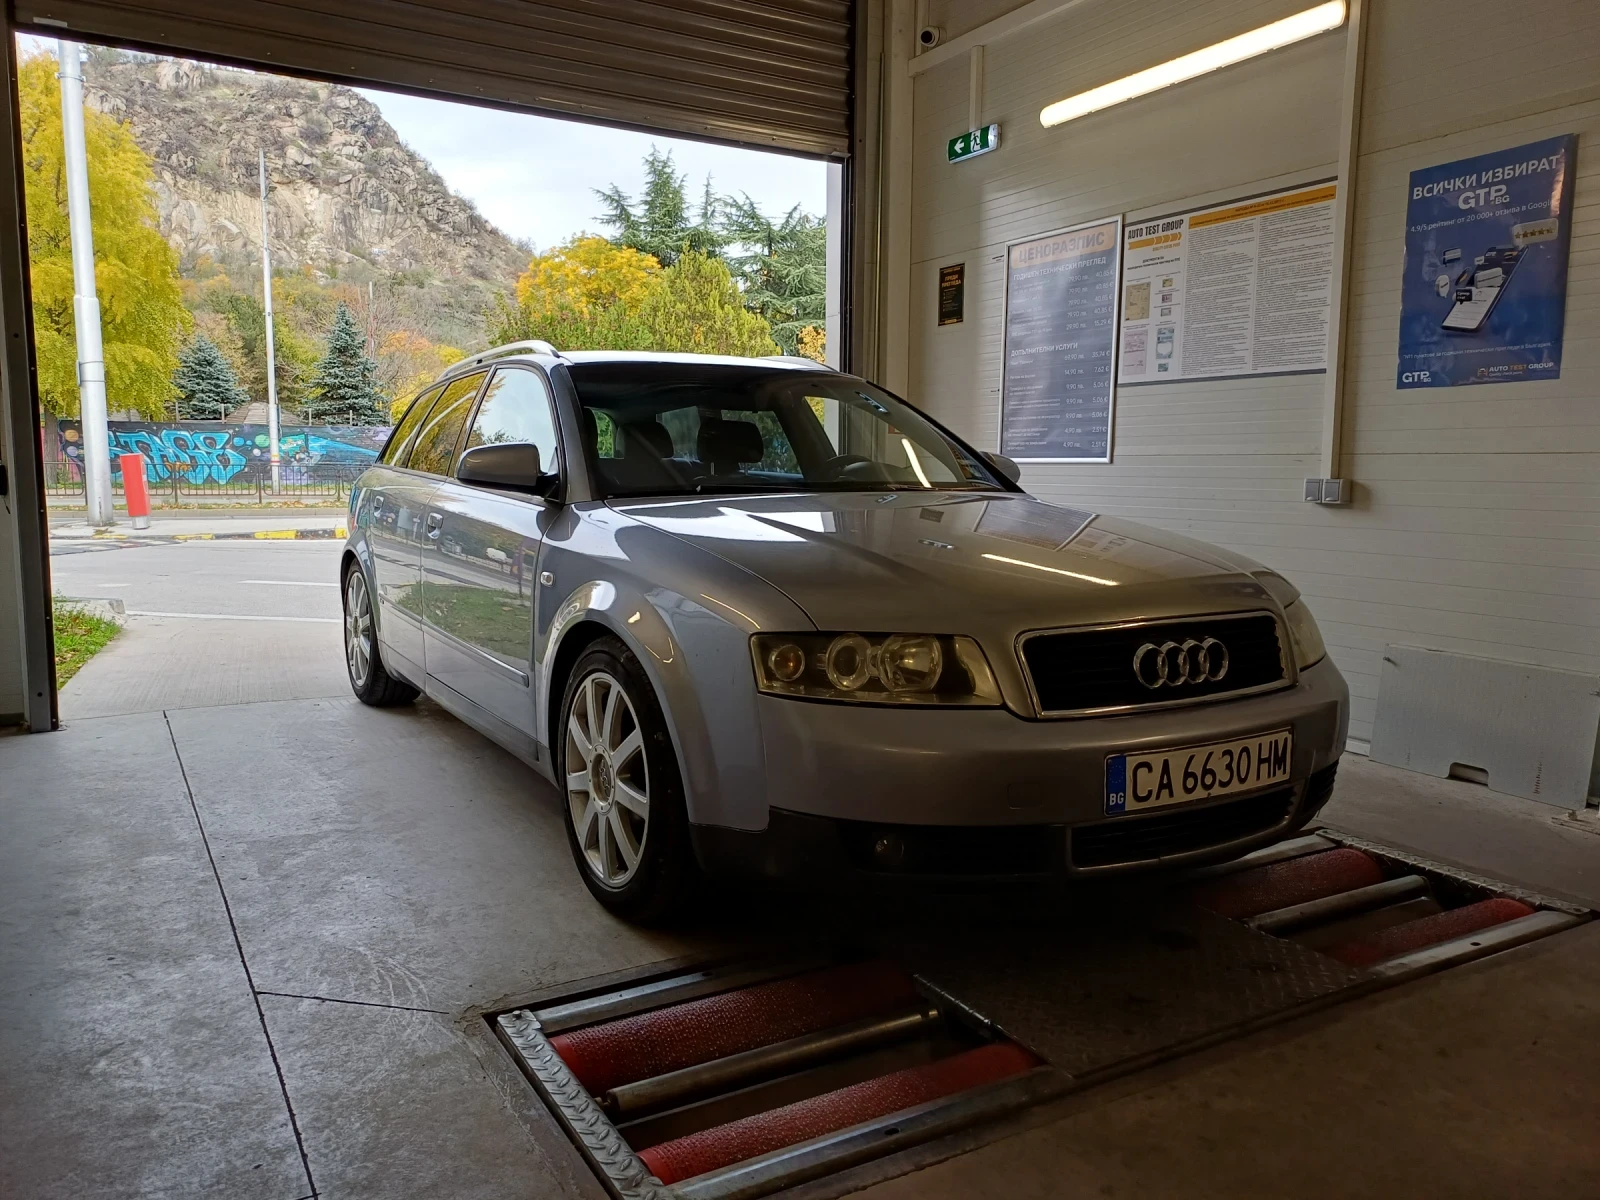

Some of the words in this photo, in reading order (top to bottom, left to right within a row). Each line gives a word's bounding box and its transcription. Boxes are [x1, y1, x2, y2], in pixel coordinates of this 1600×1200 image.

[1412, 173, 1477, 200] ВСИЧКИ
[1481, 154, 1561, 184] ИЗБИРАТ
[1428, 219, 1455, 231] рейтинг
[1466, 214, 1475, 222] 20
[1527, 199, 1553, 210] Googl
[1127, 227, 1143, 240] AUTO
[1145, 223, 1160, 236] TEST
[1161, 219, 1184, 233] GROUP
[1019, 231, 1105, 263] ЦЕНОРАЗПИС
[1013, 270, 1039, 281] ГОДИШЕН
[1039, 262, 1077, 276] ТЕХНИЧЕСКИ
[1077, 256, 1107, 268] ПРЕГЛЕД
[1010, 345, 1054, 358] ДОПЪЛНИТЕЛНИ
[1055, 342, 1078, 352] УСЛУГИ
[1528, 362, 1554, 370] GROUP
[1131, 758, 1175, 803] CA
[1182, 745, 1252, 795] 6630
[1255, 736, 1289, 782] HM
[1109, 792, 1125, 806] BG
